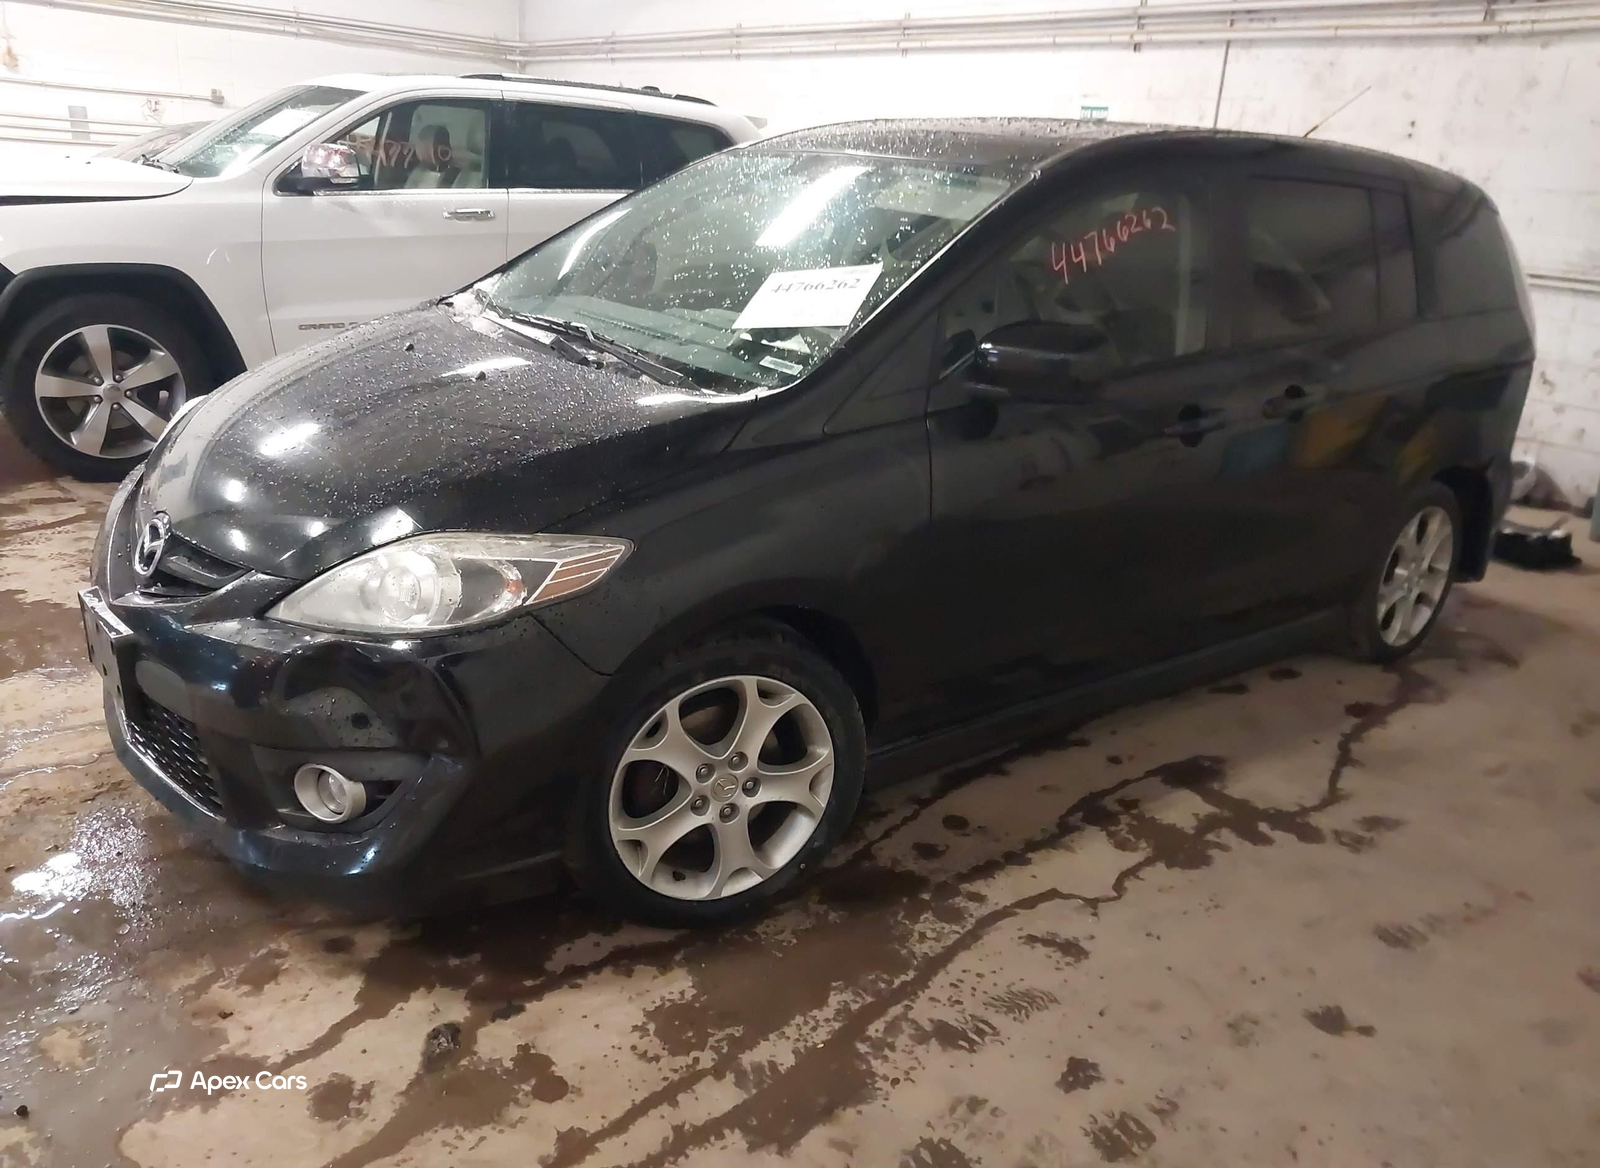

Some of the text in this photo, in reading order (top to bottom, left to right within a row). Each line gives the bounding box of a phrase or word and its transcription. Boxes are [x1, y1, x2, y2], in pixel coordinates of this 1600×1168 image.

[1051, 206, 1176, 284] 44766262
[770, 278, 861, 294] 44766262
[298, 322, 345, 330] GRAND
